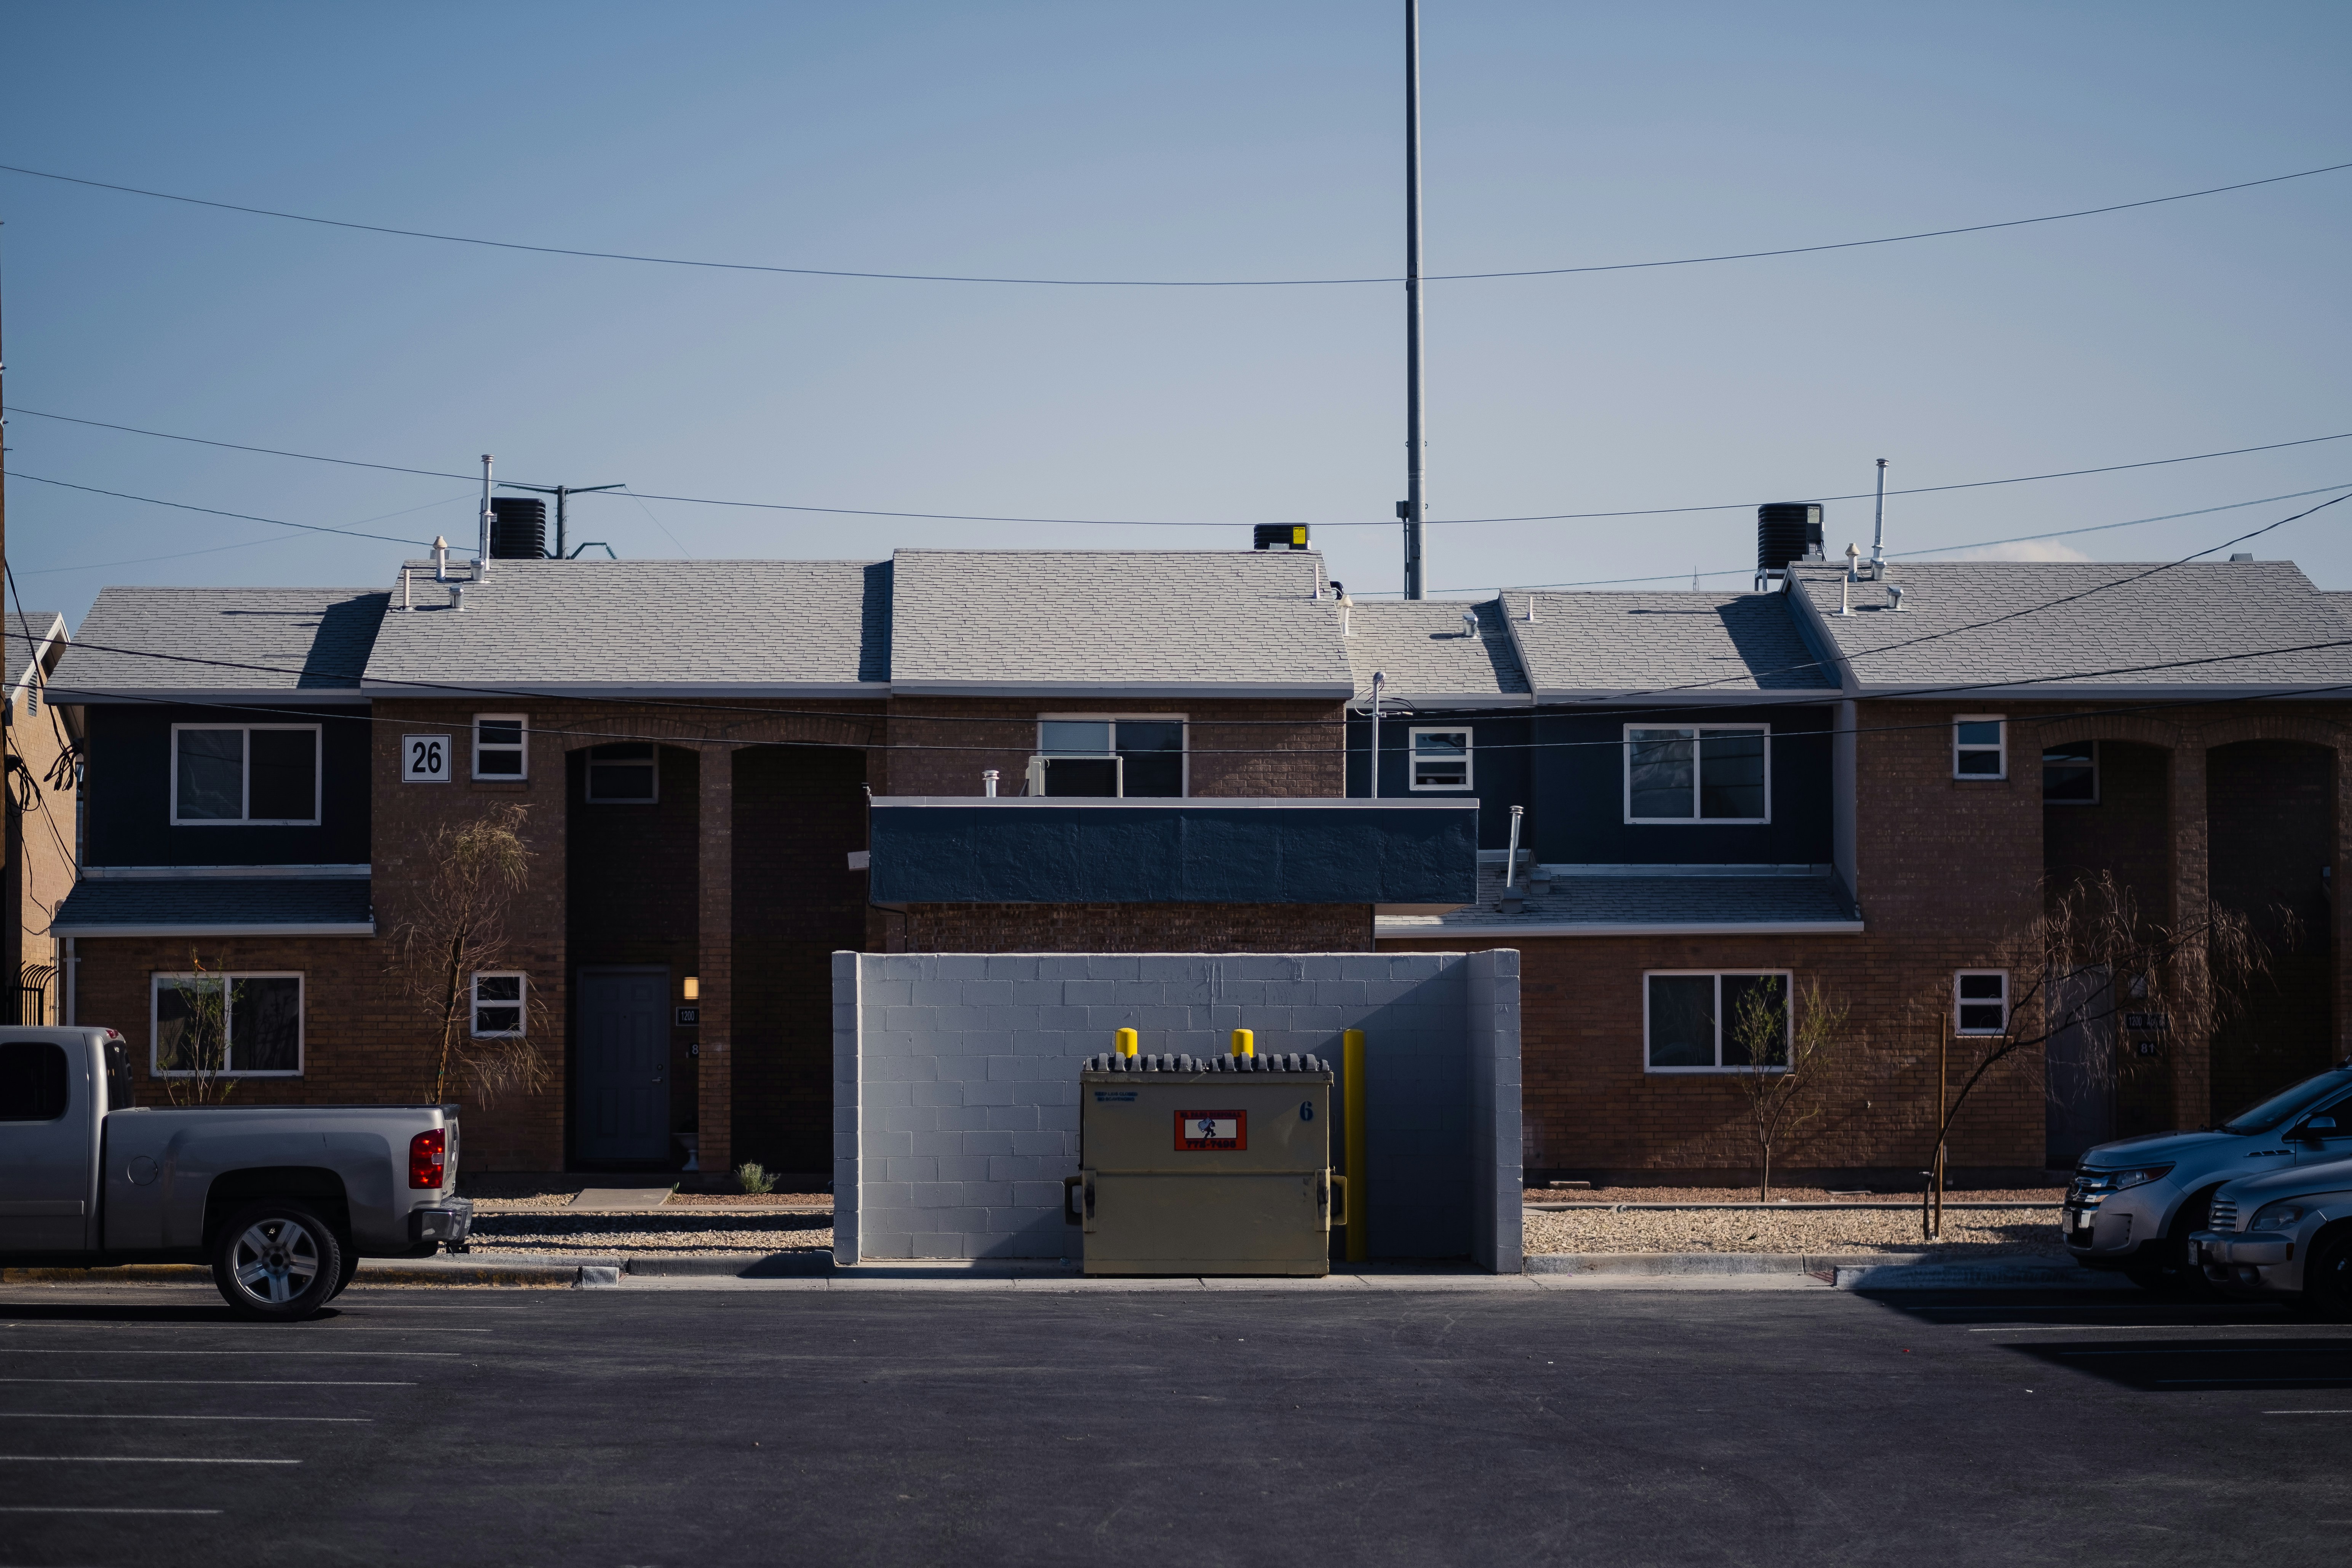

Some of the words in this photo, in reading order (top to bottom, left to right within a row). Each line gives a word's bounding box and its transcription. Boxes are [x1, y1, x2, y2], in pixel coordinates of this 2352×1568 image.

[412, 741, 441, 774] 26
[681, 1010, 694, 1021] 1200
[2129, 1015, 2142, 1026] 1200
[2141, 1043, 2154, 1054] 81
[1300, 1101, 1313, 1121] 6
